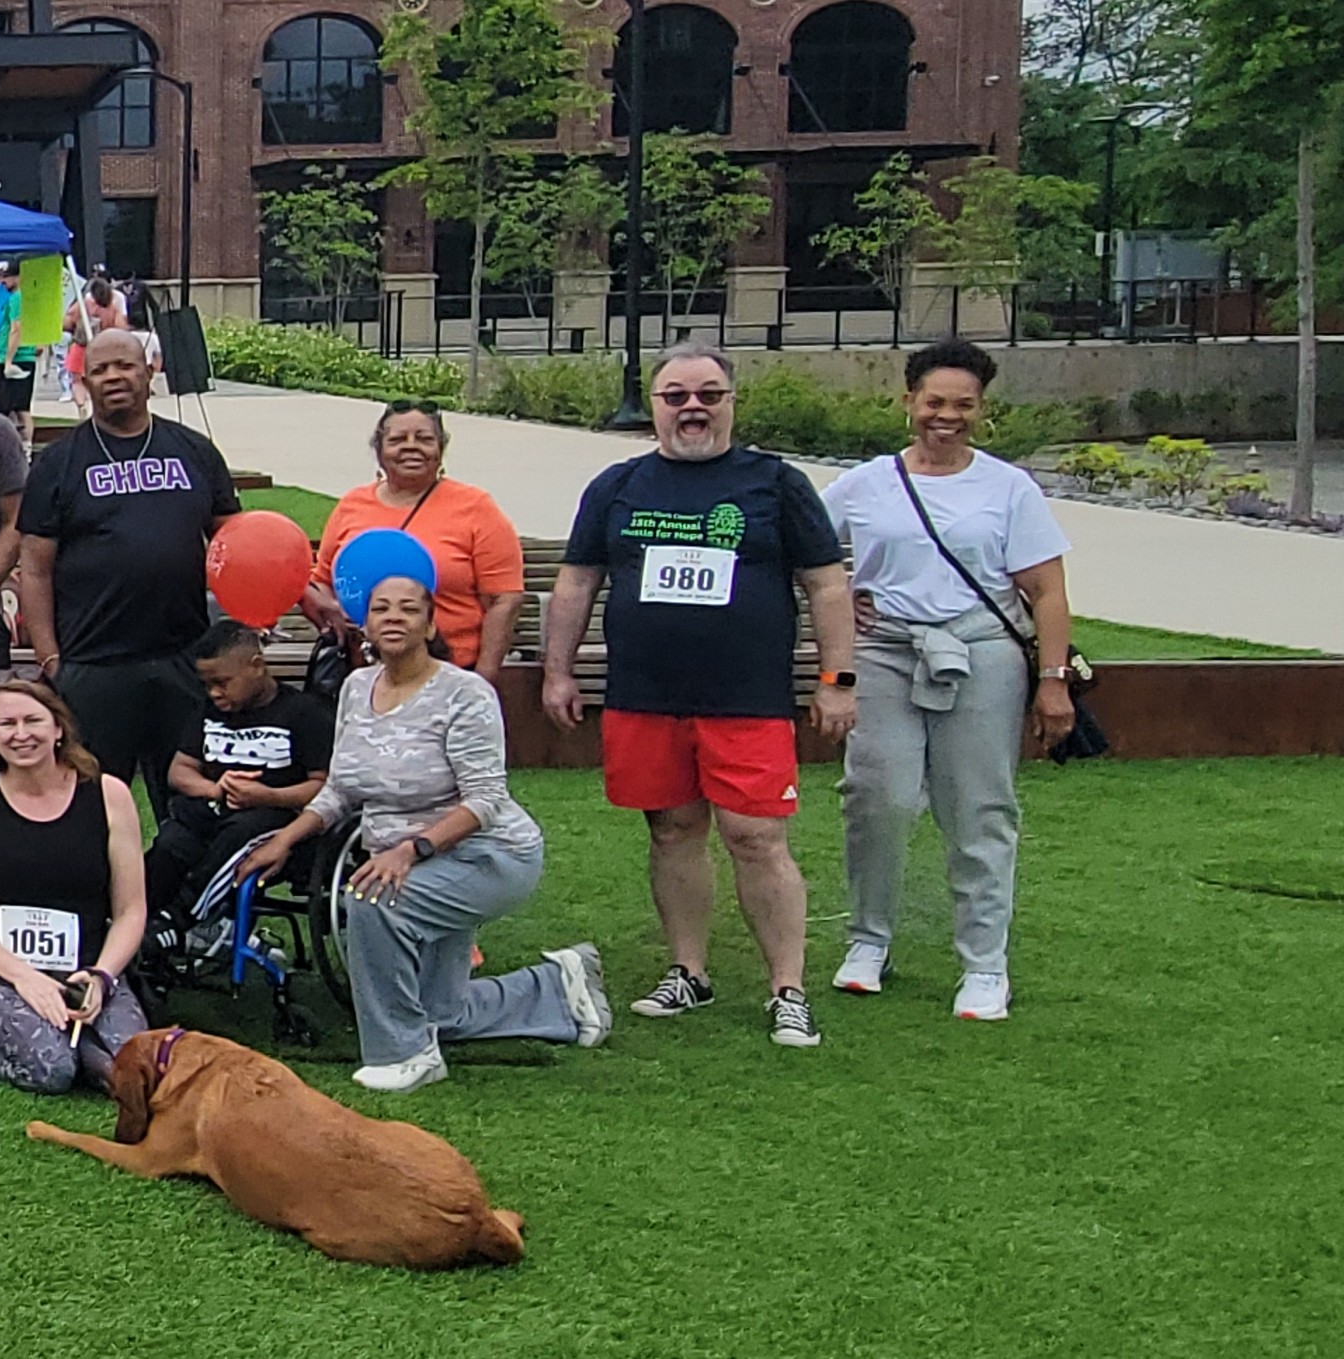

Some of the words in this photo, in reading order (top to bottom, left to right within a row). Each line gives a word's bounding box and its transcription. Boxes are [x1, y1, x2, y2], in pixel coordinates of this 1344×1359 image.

[85, 457, 192, 497] CHCA
[656, 530, 672, 539] for
[658, 520, 702, 530] Annual
[659, 566, 715, 591] 980
[9, 928, 66, 957] 1051
